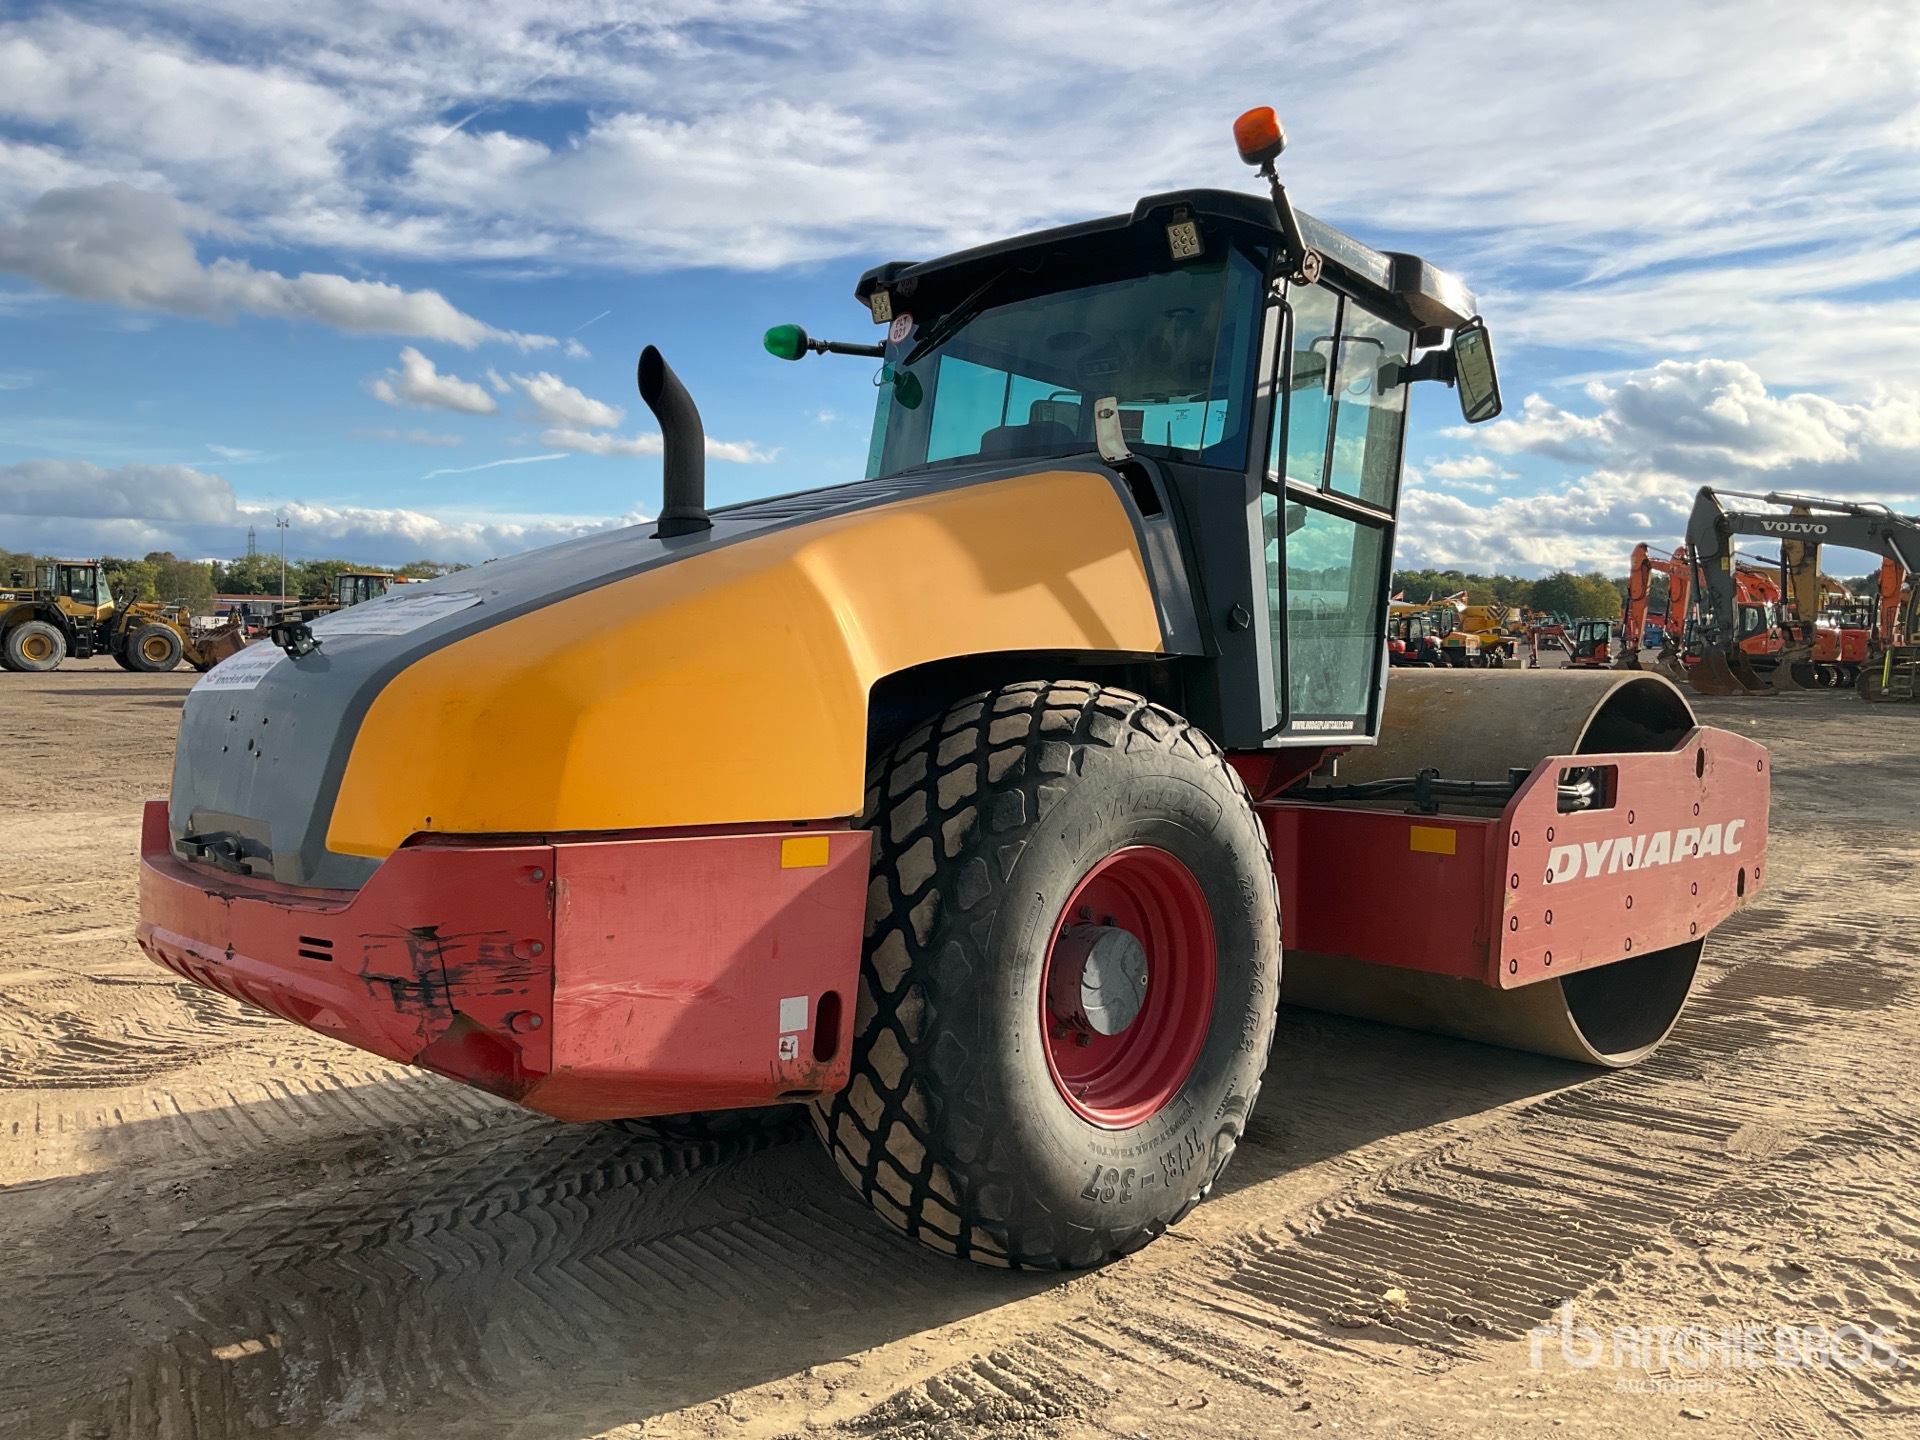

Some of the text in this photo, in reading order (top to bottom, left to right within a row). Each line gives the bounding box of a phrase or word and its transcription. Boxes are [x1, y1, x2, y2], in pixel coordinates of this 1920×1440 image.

[1761, 521, 1828, 534] VOLVO
[134, 609, 167, 624] KOMATSU
[214, 673, 262, 685] knocked down
[1078, 788, 1211, 850] DYNAPAC
[1543, 819, 1745, 885] DYNAPAC
